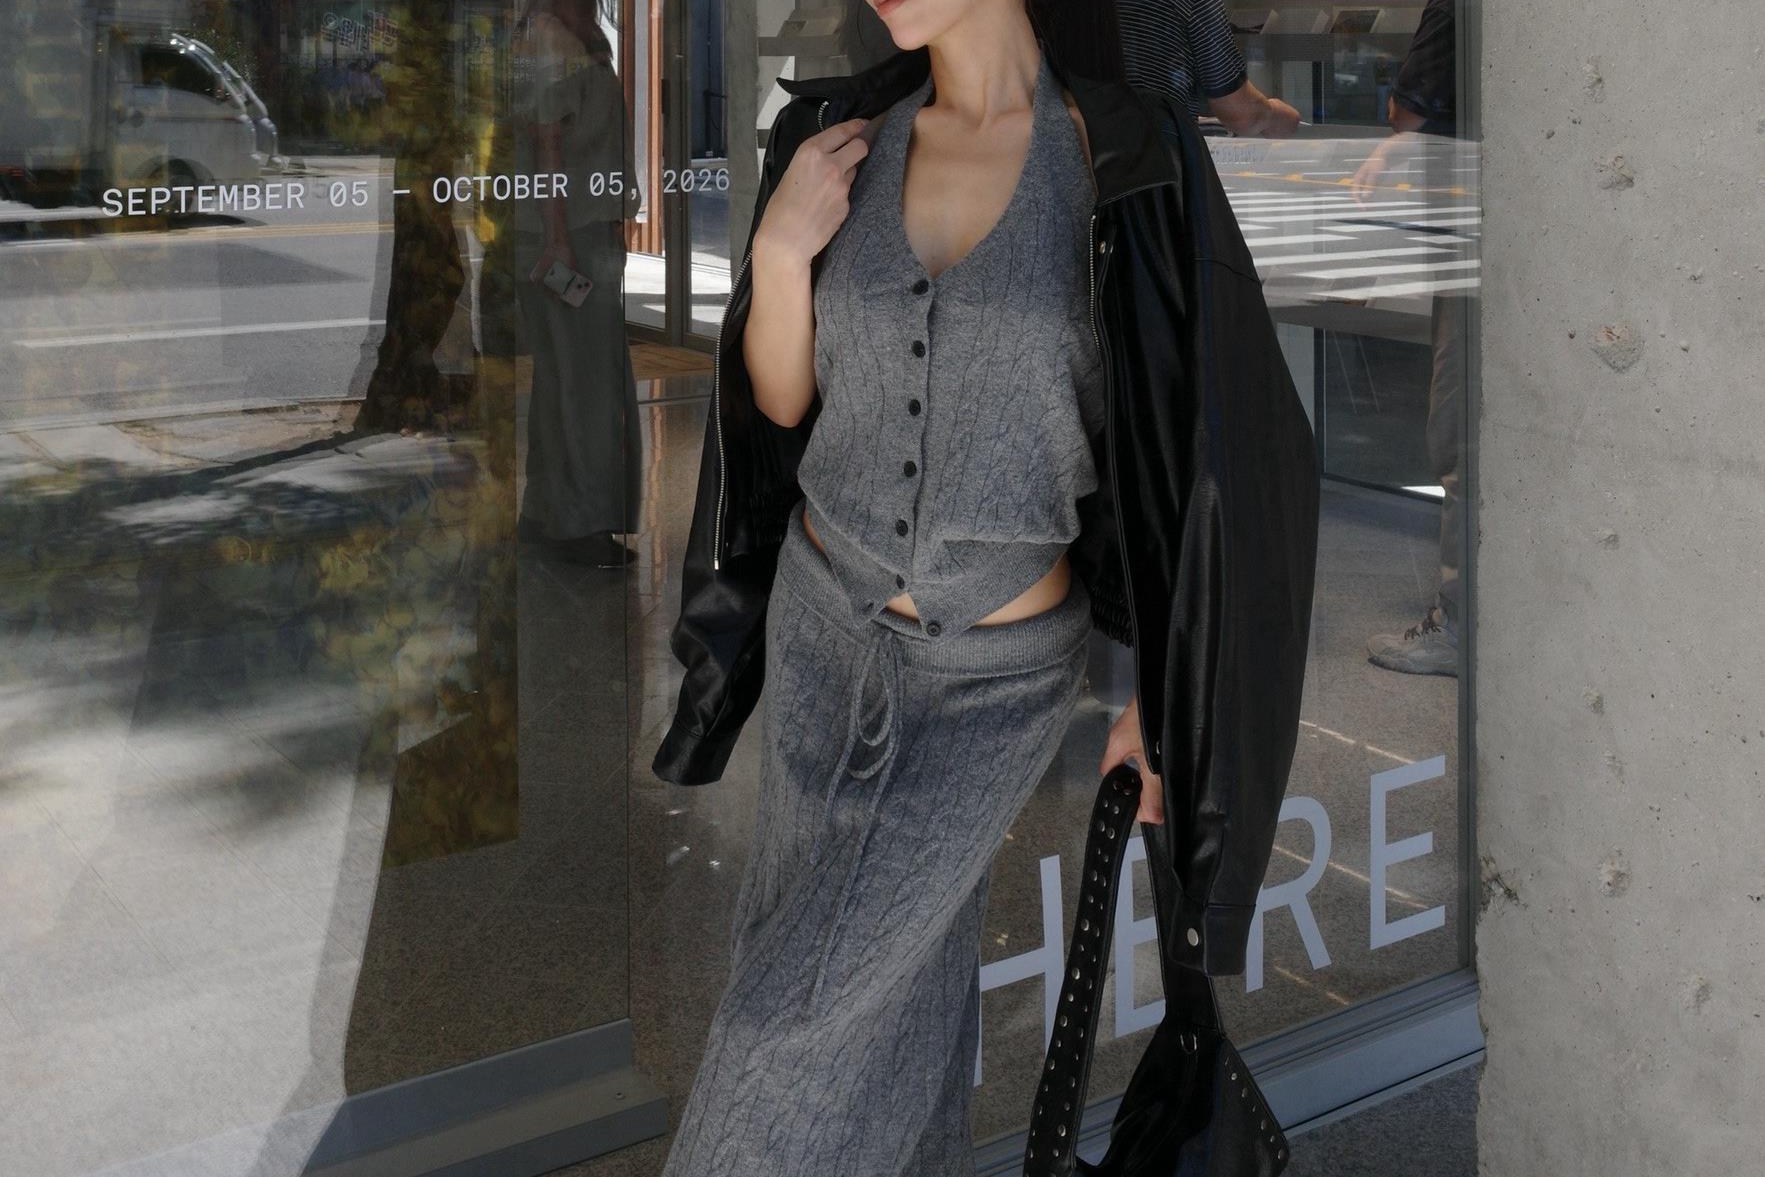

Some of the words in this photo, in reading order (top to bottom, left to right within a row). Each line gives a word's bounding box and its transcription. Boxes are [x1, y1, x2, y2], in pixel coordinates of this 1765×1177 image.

[101, 181, 305, 217] SEPTEMBER
[329, 180, 370, 207] 05
[432, 173, 569, 203] OCTOBER
[588, 171, 638, 200] 05,
[662, 167, 730, 194] 2026
[973, 754, 1446, 1087] HERE
